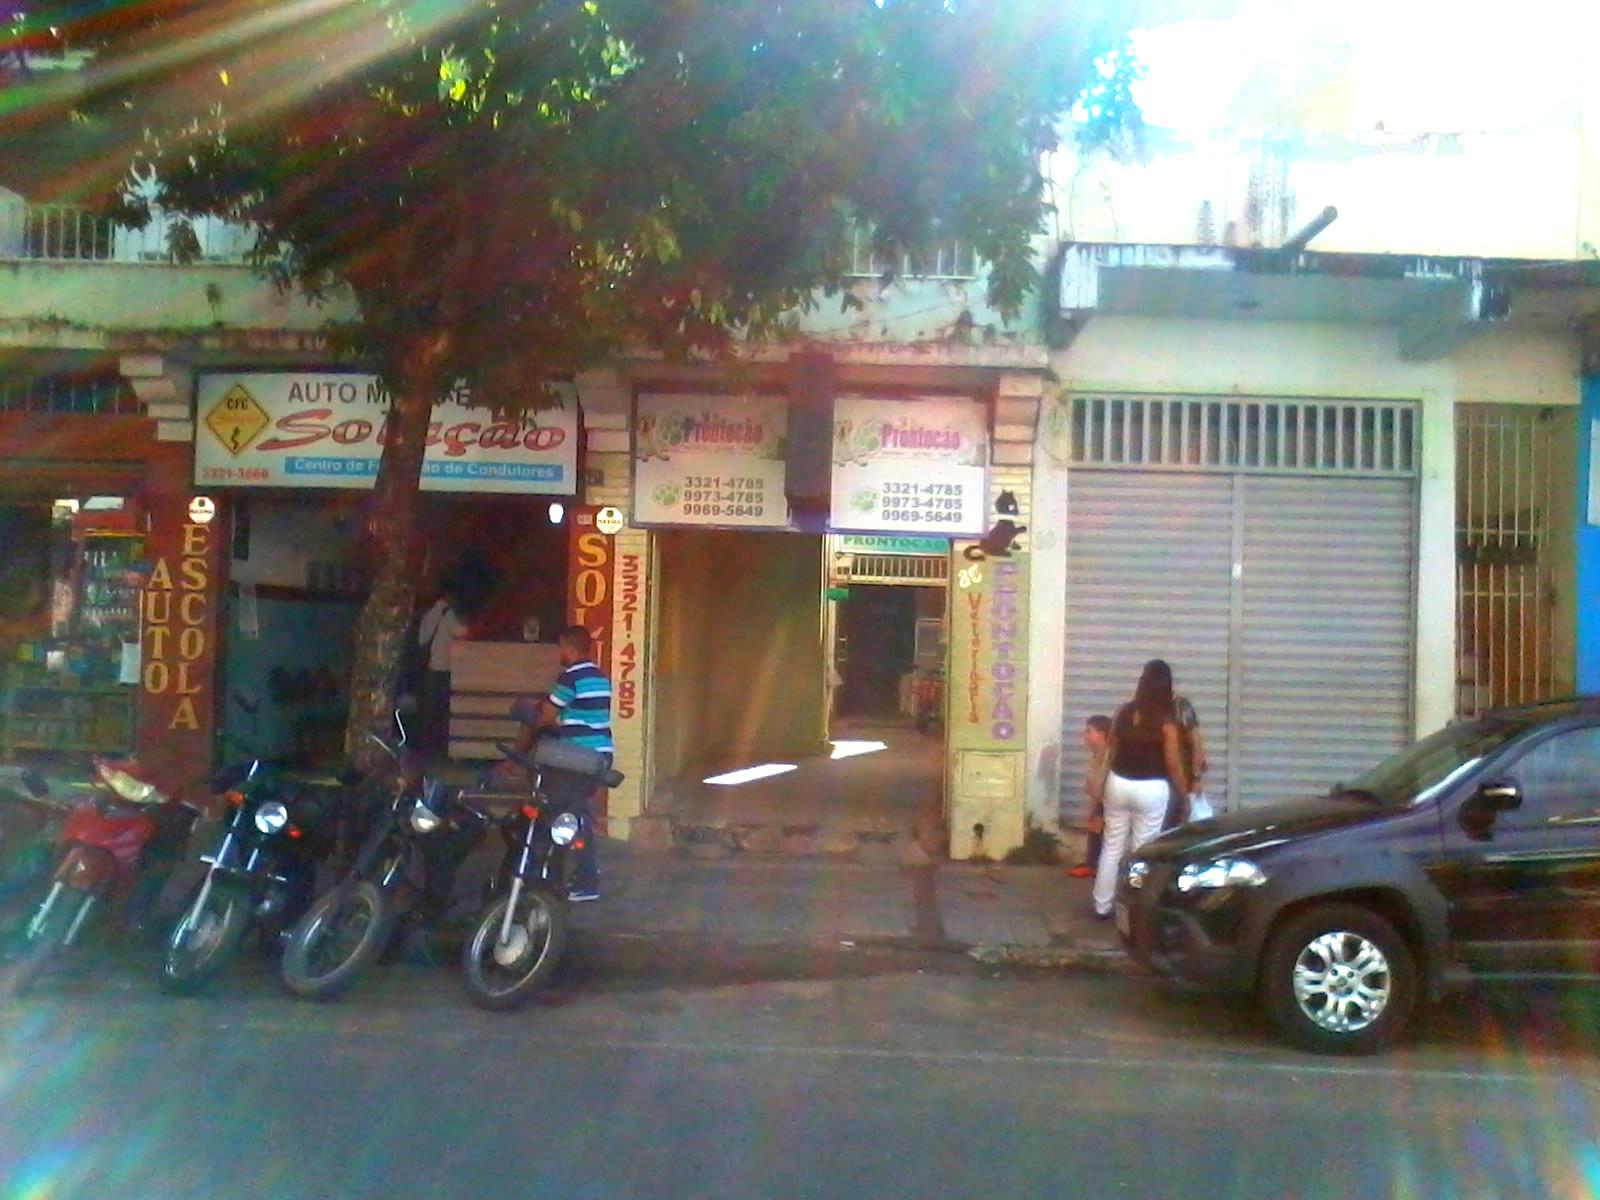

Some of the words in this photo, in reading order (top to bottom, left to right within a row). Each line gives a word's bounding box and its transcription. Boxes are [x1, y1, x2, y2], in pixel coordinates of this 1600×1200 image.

[288, 382, 357, 403] AUTO
[295, 458, 342, 471] Centro
[349, 459, 364, 472] de
[445, 462, 463, 475] de
[685, 477, 764, 489] 3321-4785
[882, 482, 963, 496] 3321-4785
[684, 490, 764, 503] 9973-4785
[881, 496, 963, 509] 9973-4785
[683, 503, 763, 516] 9969-5649
[881, 509, 962, 523] 9969-5649
[143, 557, 173, 694] AUTO
[168, 523, 210, 730] ESCOLA
